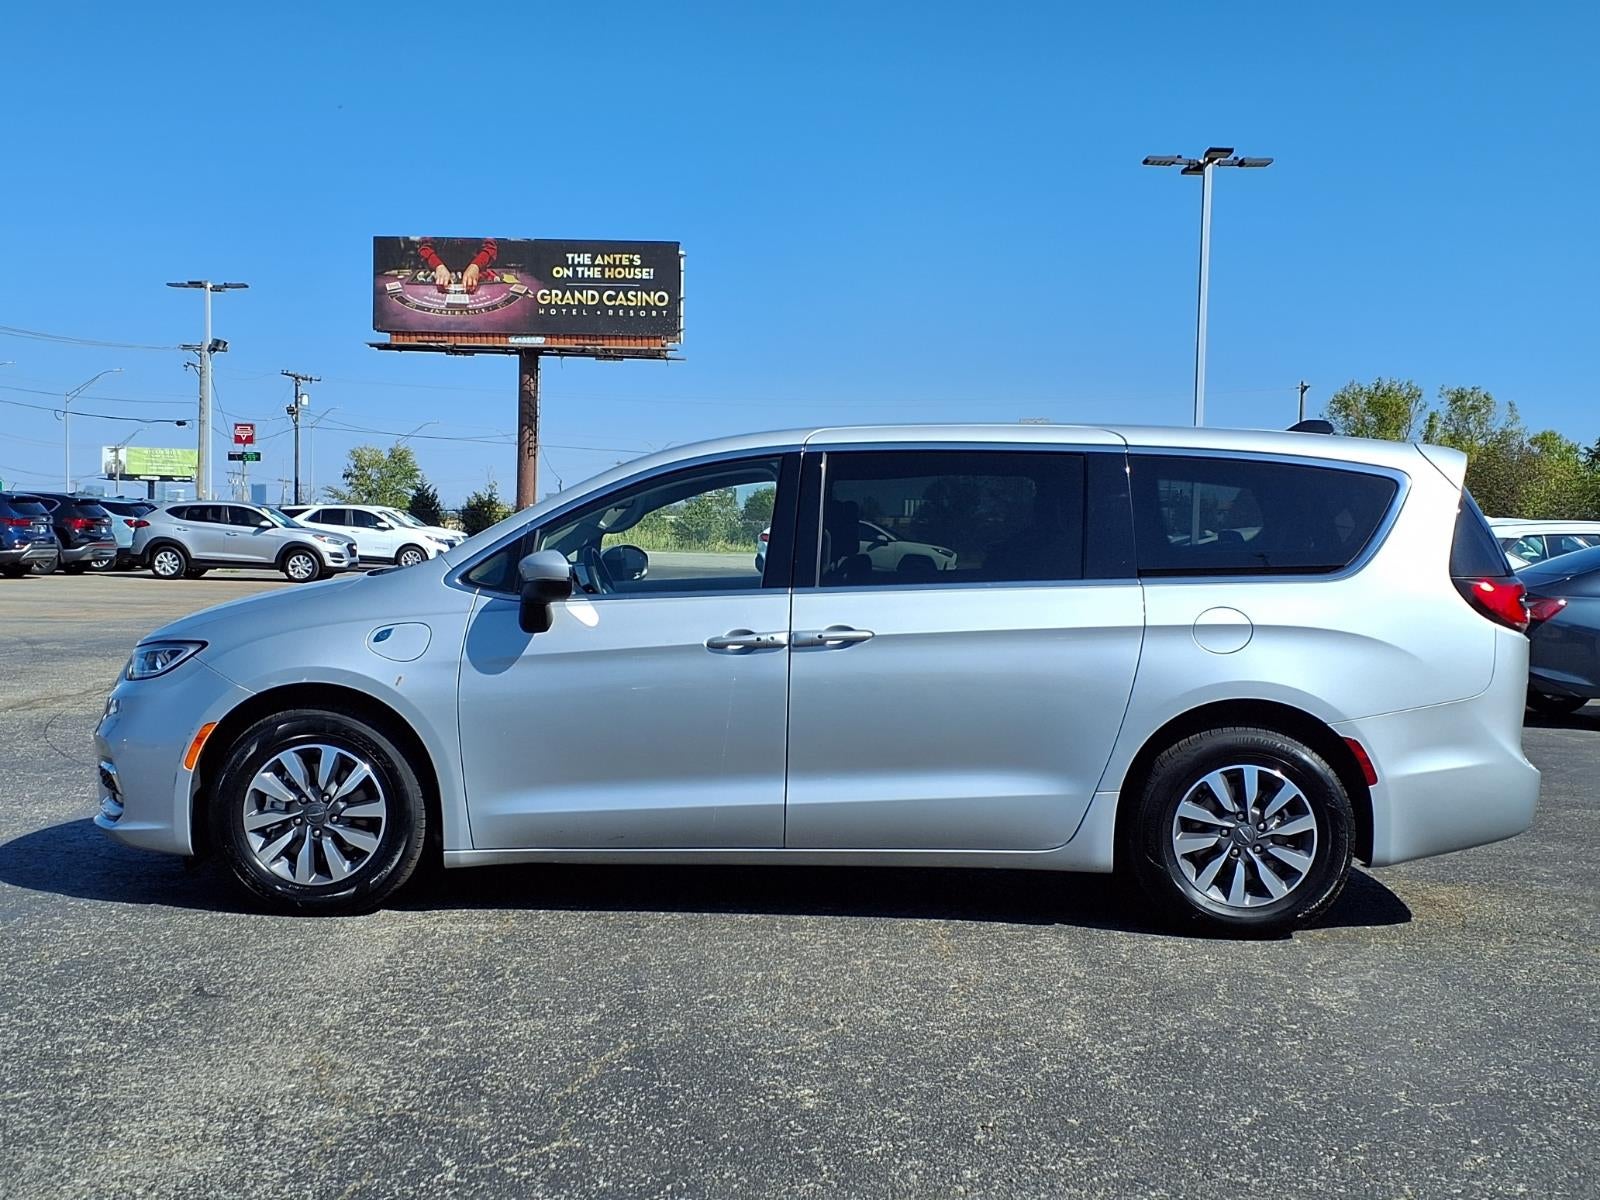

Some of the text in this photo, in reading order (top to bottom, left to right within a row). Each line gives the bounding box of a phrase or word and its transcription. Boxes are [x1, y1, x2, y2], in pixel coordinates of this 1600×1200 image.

[566, 253, 642, 266] THE ANTE'S
[552, 266, 654, 280] ON THE HOUSE!
[536, 289, 669, 307] GRAND CASINO
[538, 308, 668, 317] HOTEL RESORT
